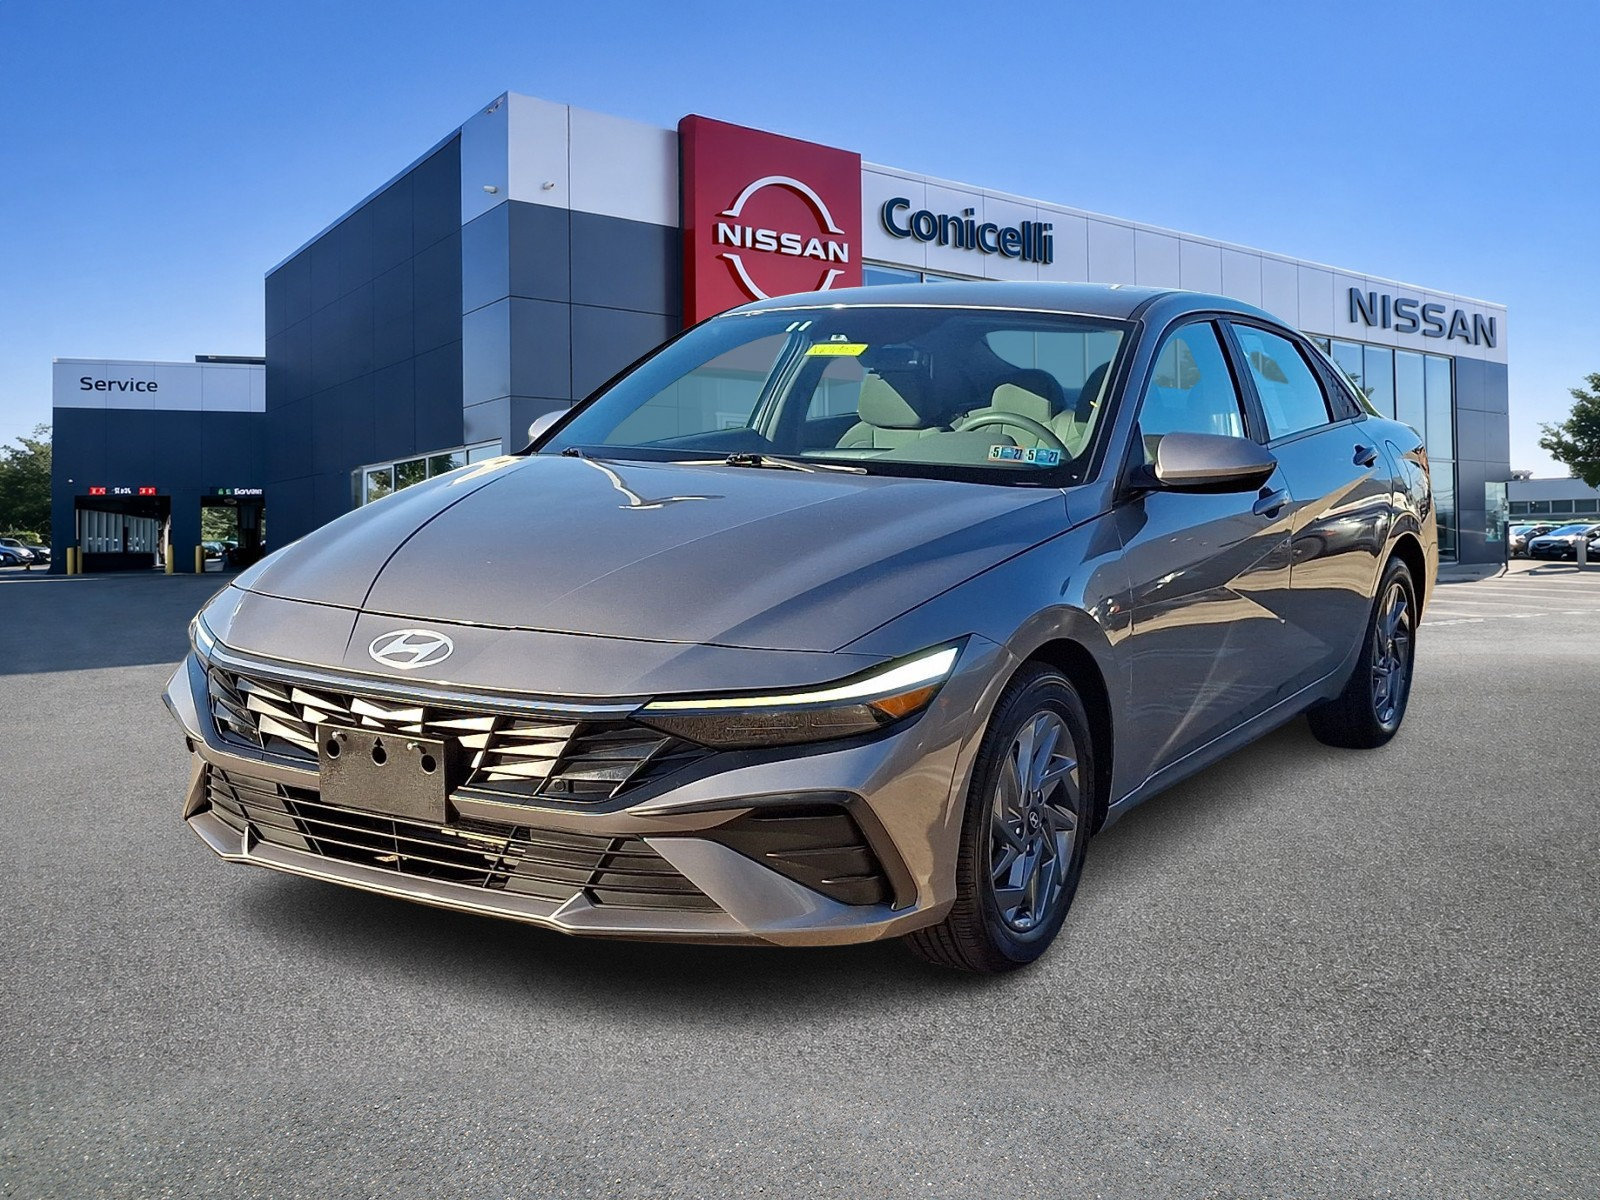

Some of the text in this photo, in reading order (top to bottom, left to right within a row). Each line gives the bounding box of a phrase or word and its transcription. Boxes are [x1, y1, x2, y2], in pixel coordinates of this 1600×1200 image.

[717, 222, 849, 263] NISSAN
[882, 197, 1053, 264] Conicelli
[1349, 287, 1497, 348] NISSAN
[80, 376, 158, 392] Service
[992, 447, 1000, 458] 5
[1027, 450, 1035, 461] 5
